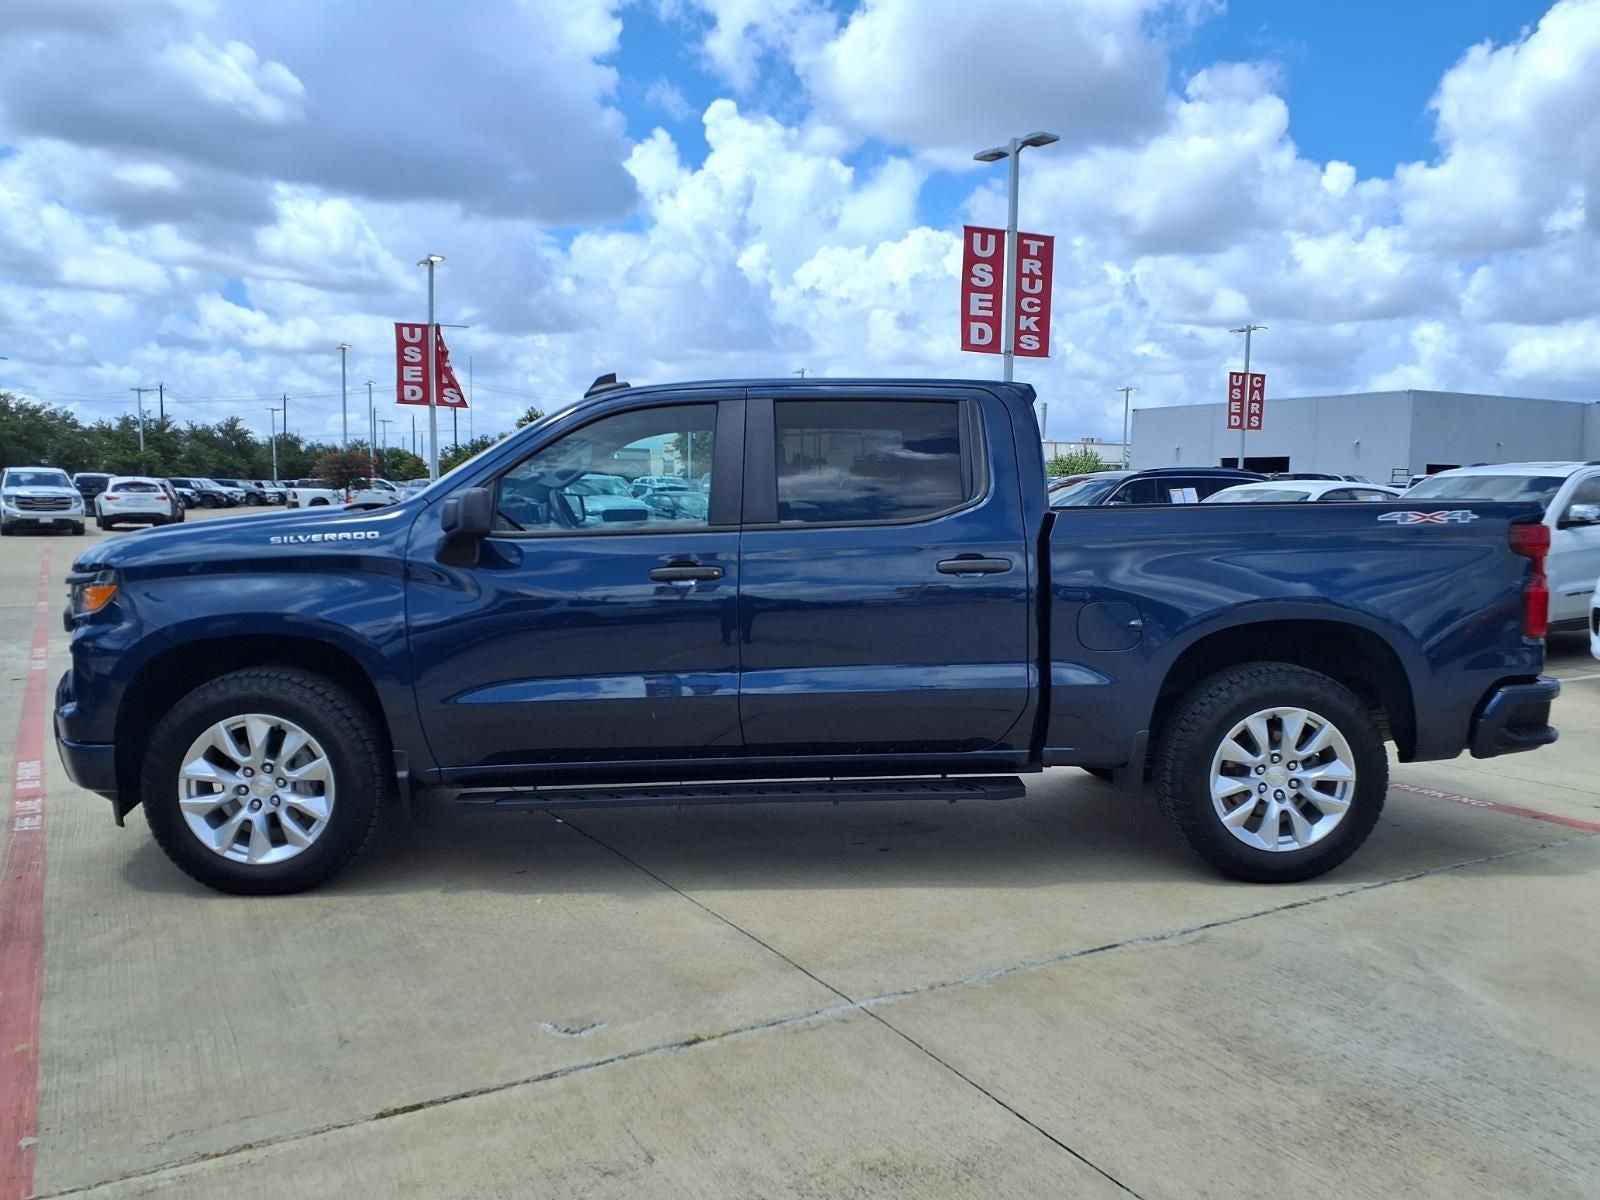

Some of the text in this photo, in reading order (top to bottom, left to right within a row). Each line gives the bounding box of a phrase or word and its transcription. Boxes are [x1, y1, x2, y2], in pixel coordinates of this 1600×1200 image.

[970, 232, 996, 346] USED
[1019, 239, 1045, 350] TRUCKS
[402, 327, 423, 401] USED
[1231, 375, 1243, 426] USED
[1250, 376, 1262, 427] CARS
[269, 530, 380, 545] SILVERADO
